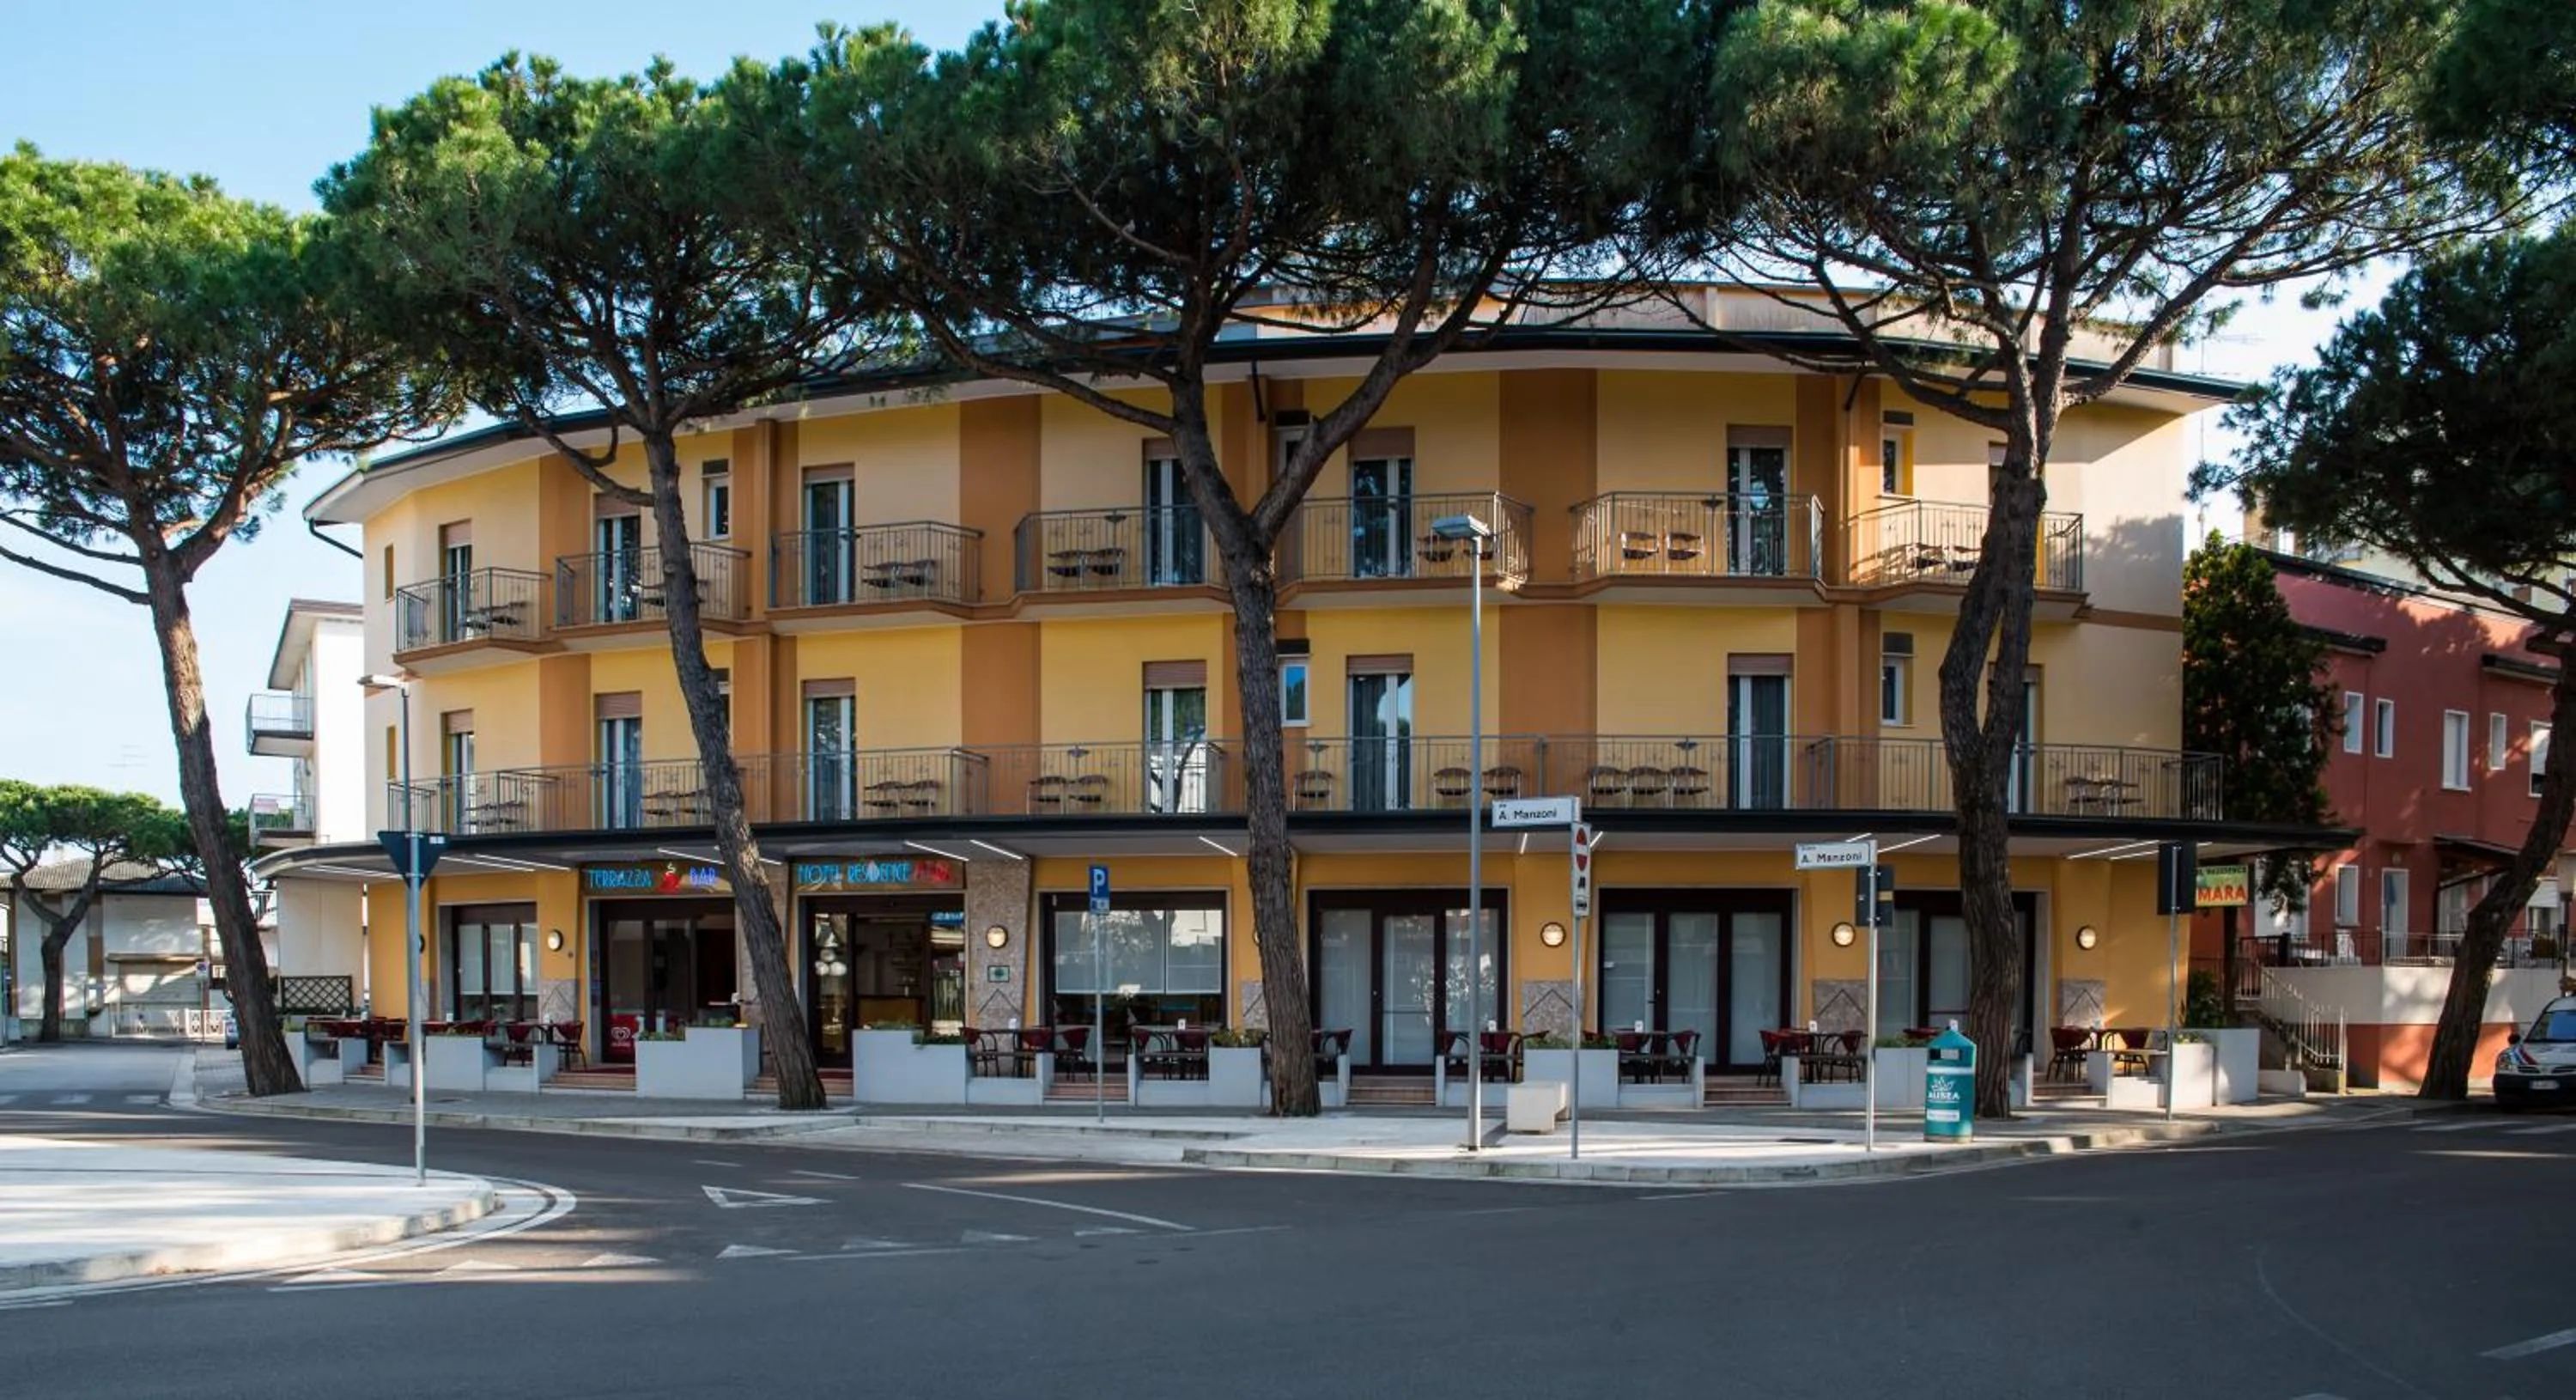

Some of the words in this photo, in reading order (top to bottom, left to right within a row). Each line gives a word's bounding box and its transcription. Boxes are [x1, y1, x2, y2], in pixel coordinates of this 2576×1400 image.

[1514, 808, 1558, 819] Manzoni
[1816, 852, 1862, 863] Manzoni
[587, 868, 653, 888] TERRAZZA
[690, 866, 717, 886] BAR
[1093, 868, 1106, 894] P
[2197, 884, 2247, 901] MARA
